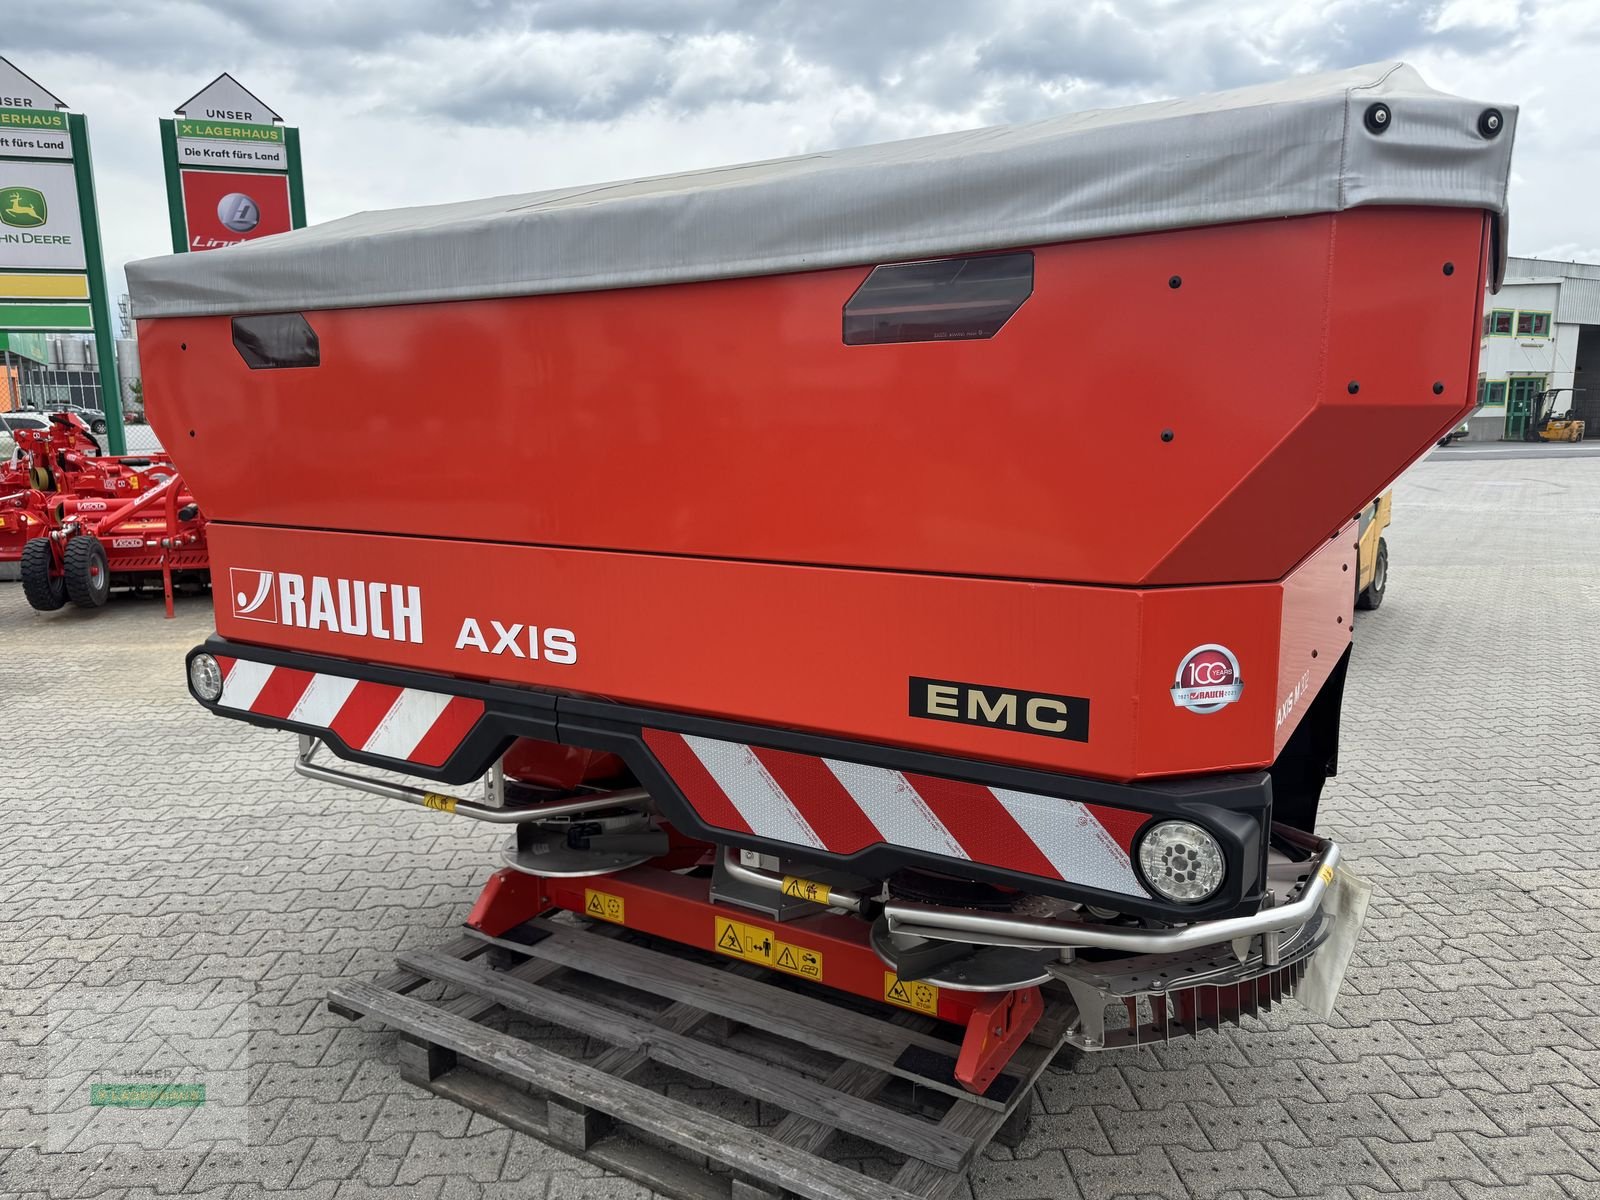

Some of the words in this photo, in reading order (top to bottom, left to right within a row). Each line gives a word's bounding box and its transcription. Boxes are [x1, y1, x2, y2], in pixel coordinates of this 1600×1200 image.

[0, 97, 33, 107] SER
[206, 109, 253, 121] UNSER
[196, 126, 278, 140] LAGERHAUS
[12, 138, 34, 148] fürs
[37, 140, 64, 149] Land
[185, 148, 201, 156] Die
[203, 149, 230, 158] Kraft
[232, 151, 253, 160] fürs
[255, 152, 280, 161] Land
[22, 232, 72, 245] DEERE
[279, 573, 423, 644] RAUCH
[455, 617, 578, 666] AXIS
[1189, 662, 1227, 686] 100
[1200, 690, 1224, 700] RAUCH
[927, 684, 1068, 734] EMC
[1276, 691, 1293, 731] AXIS
